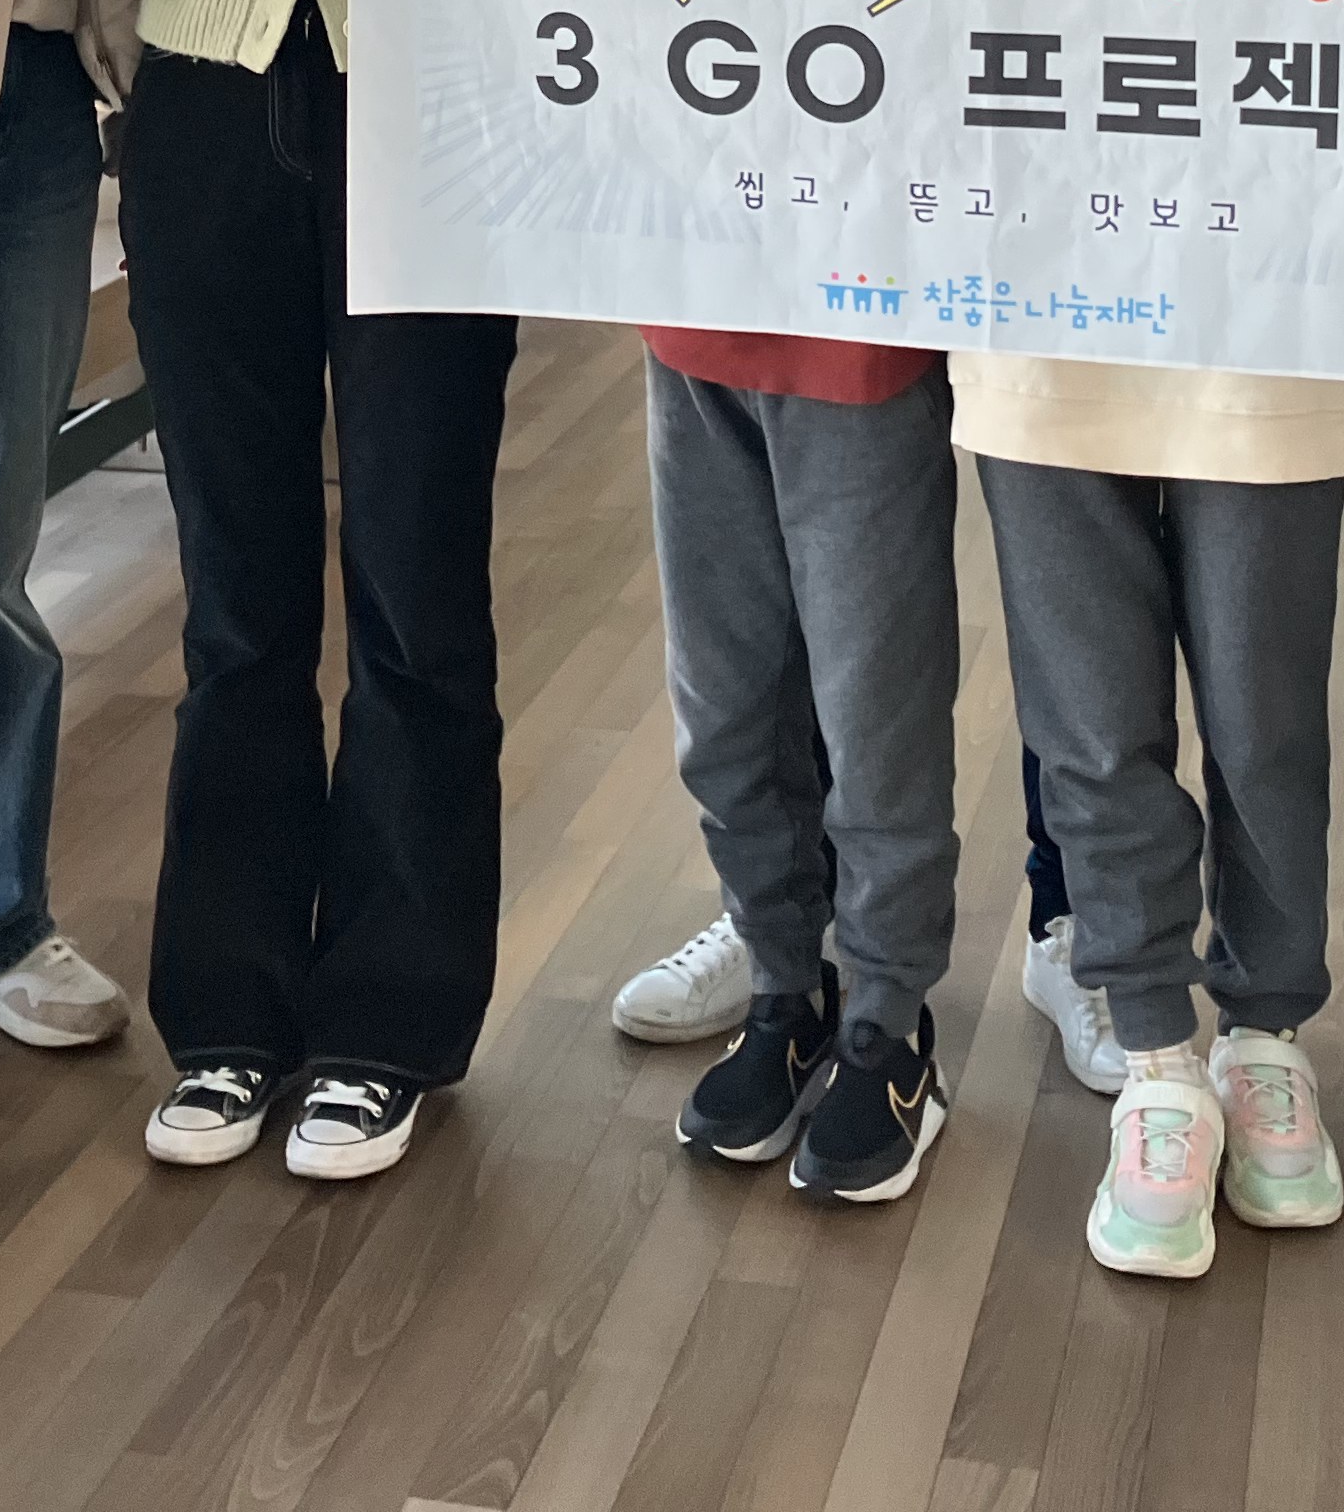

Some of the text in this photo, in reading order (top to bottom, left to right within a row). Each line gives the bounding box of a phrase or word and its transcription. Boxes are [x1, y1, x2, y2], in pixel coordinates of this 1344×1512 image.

[535, 11, 599, 106] 3
[667, 19, 886, 123] GO
[1090, 192, 1240, 233] 맛보고
